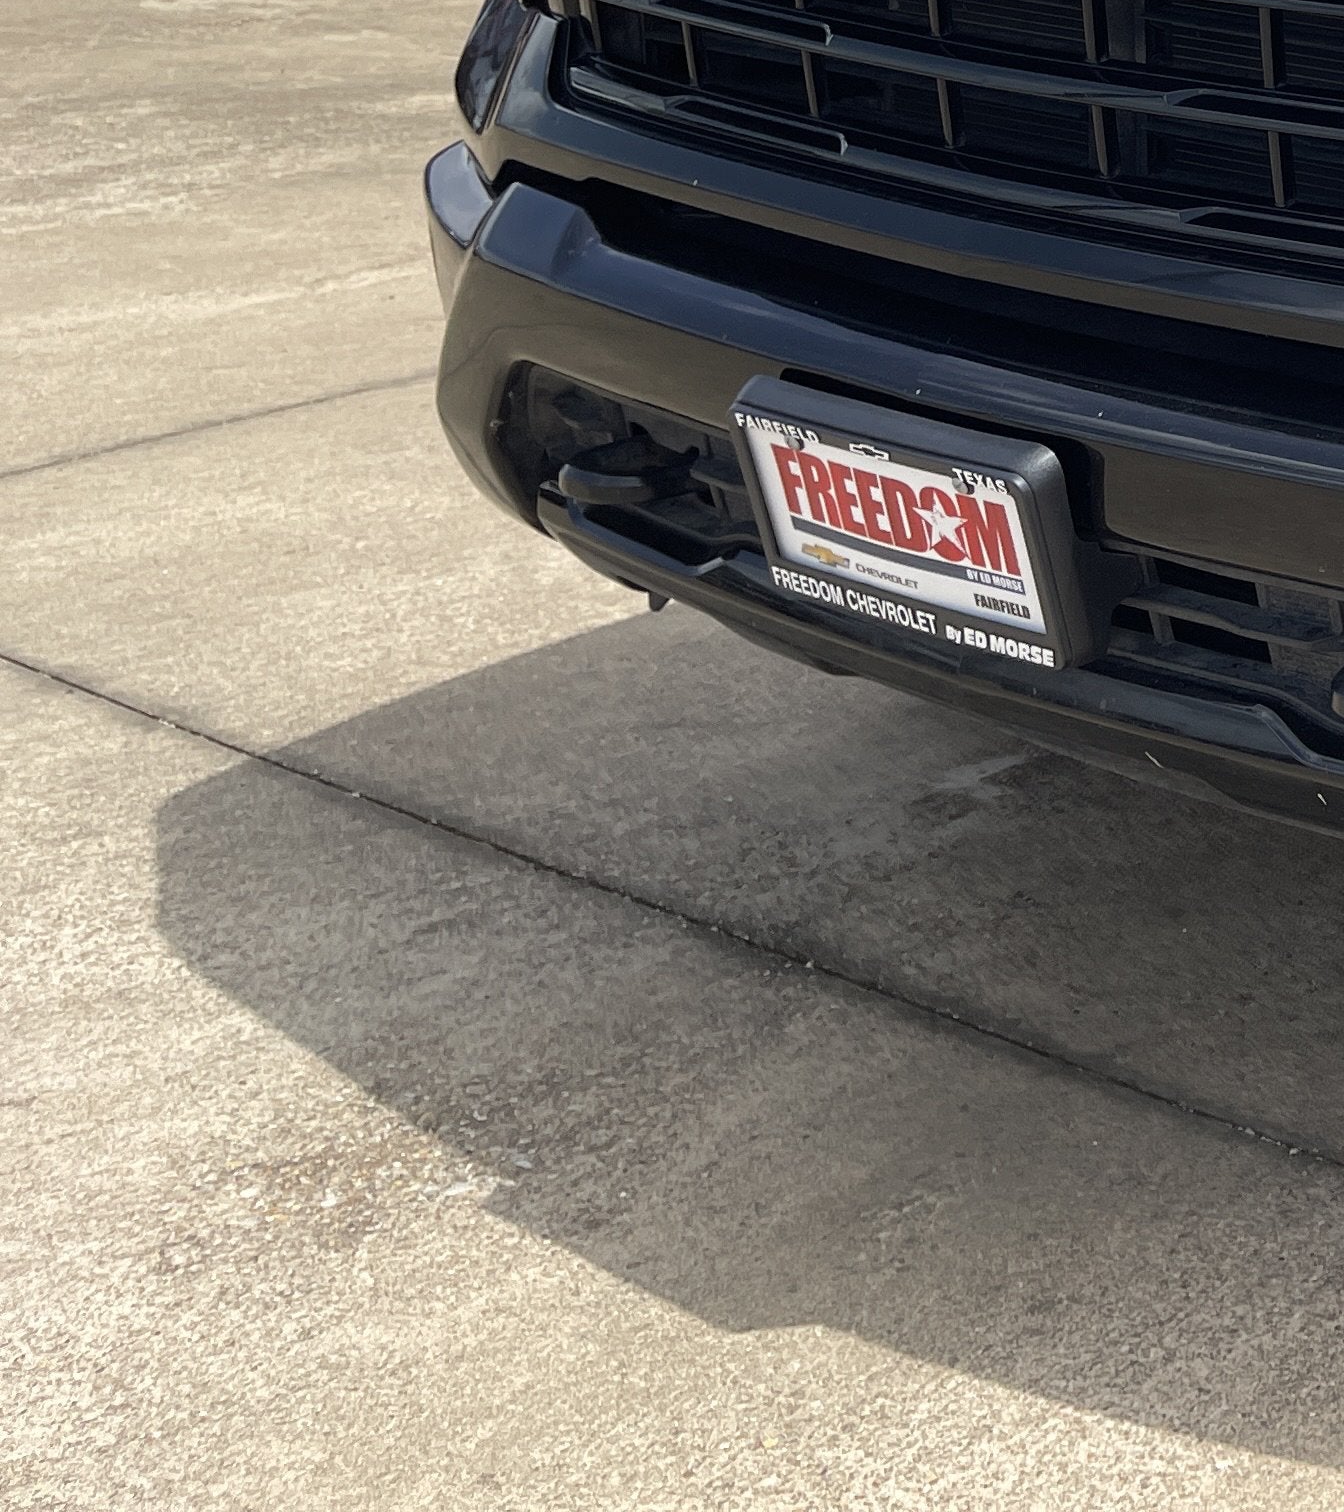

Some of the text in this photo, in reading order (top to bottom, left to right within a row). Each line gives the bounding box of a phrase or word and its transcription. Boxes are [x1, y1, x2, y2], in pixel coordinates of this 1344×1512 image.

[734, 412, 820, 443] FAIRFIELD
[951, 467, 1009, 495] TEXAS
[770, 443, 1021, 576] FREEDOM
[855, 562, 919, 590] CHEVROLET
[965, 569, 1025, 594] BY ED MORSE
[771, 566, 1056, 669] FREEDOM CHEVROLET By ED MORSE
[973, 593, 1032, 620] FAIRFIELD
